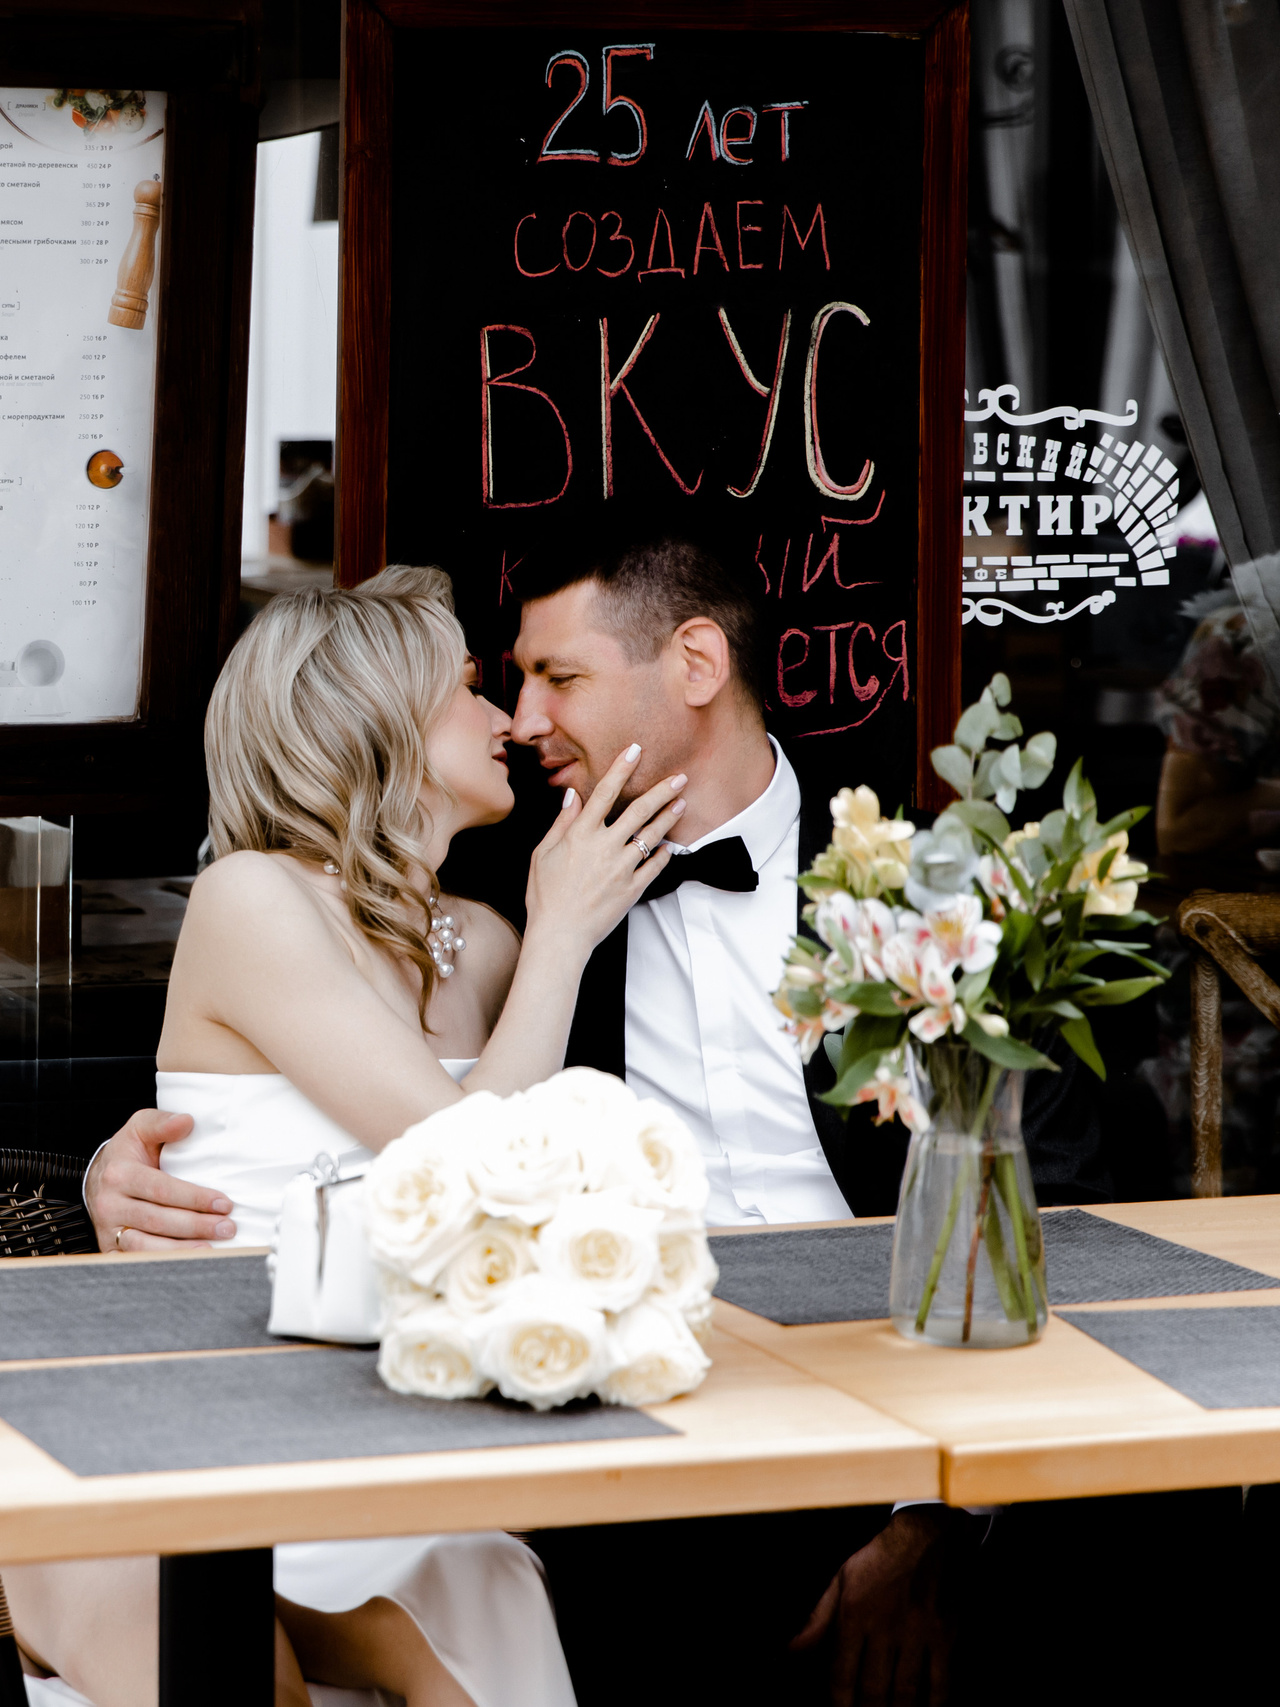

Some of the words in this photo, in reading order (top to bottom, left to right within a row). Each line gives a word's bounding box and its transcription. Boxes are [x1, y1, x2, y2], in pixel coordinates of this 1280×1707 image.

[538, 43, 655, 165] 25
[686, 100, 809, 165] лет
[33, 238, 77, 247] грибочками
[514, 201, 831, 282] СОЗДАЕМ
[480, 301, 875, 509] ВКУС
[973, 432, 1087, 480] БСКИЙ
[963, 495, 1113, 537] КТИР
[963, 567, 1007, 581] ФЕ
